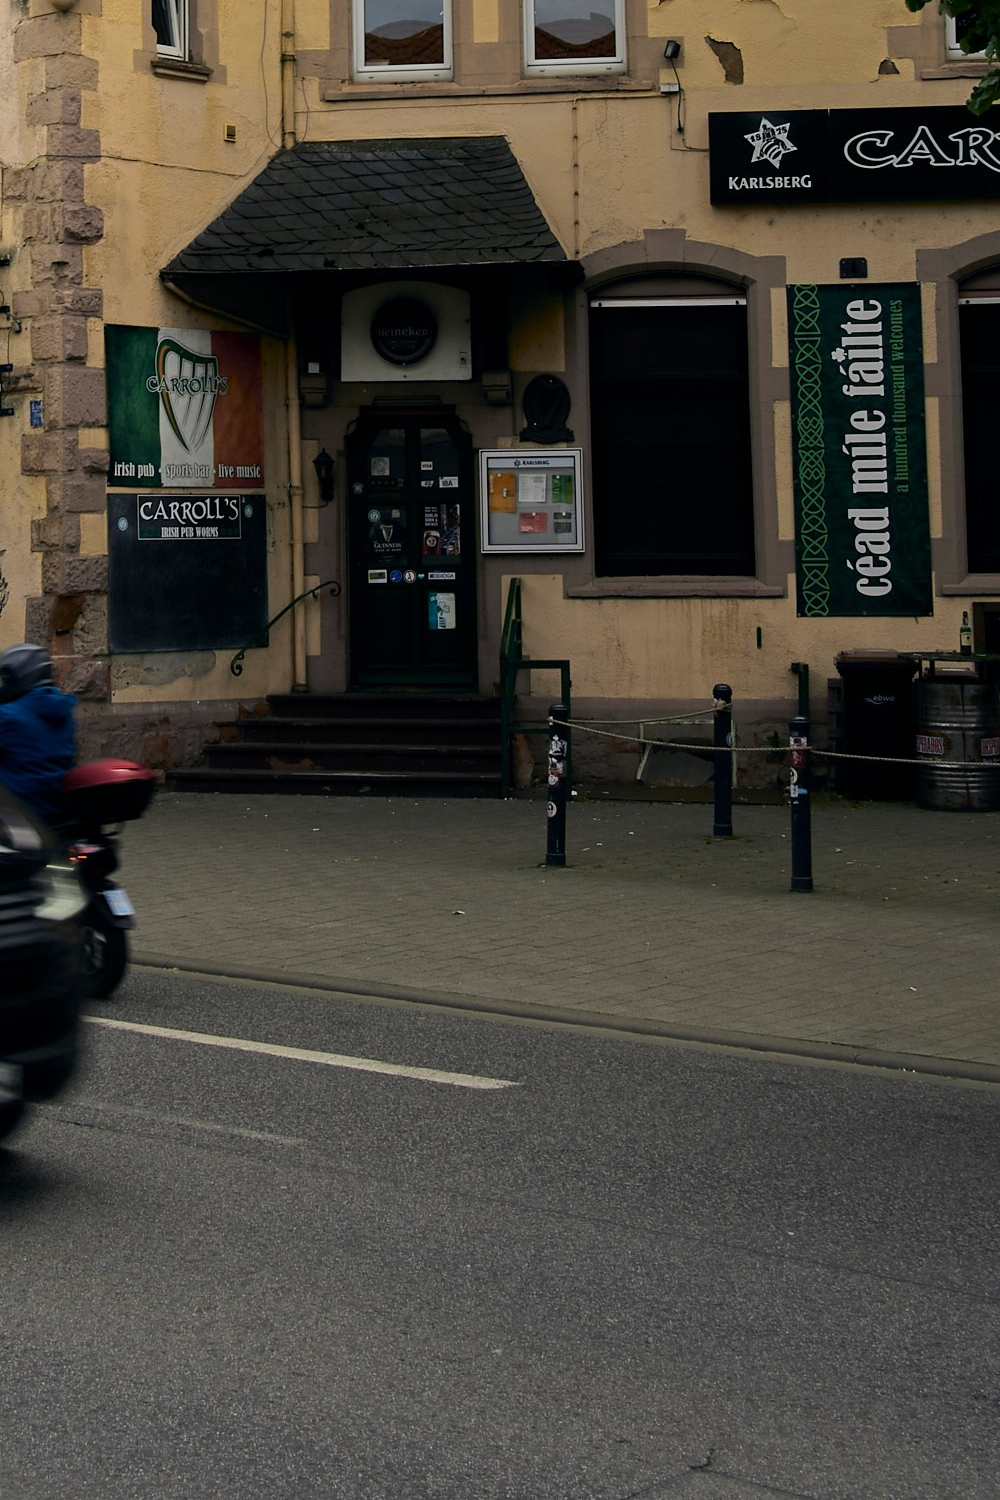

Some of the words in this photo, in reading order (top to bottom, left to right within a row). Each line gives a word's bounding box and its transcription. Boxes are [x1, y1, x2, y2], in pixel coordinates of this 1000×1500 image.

[843, 125, 1000, 173] CAR
[728, 175, 812, 190] KARLSBERG
[378, 326, 429, 338] Heineken
[839, 299, 885, 397] fáilte
[889, 299, 905, 361] welcomes
[146, 374, 229, 397] CARROLL'S
[891, 364, 907, 423] thousand
[114, 461, 136, 477] irish
[137, 463, 155, 479] pub
[166, 464, 194, 479] sports
[194, 463, 210, 478] bar
[218, 464, 235, 478] live
[236, 464, 261, 479] music
[842, 409, 889, 494] míle
[894, 426, 909, 481] hundred
[896, 484, 910, 493] a
[140, 498, 239, 525] CARROLL'S
[161, 527, 180, 538] IRISH
[181, 527, 195, 538] PUB
[196, 527, 219, 538] WORMS
[846, 506, 893, 597] céad
